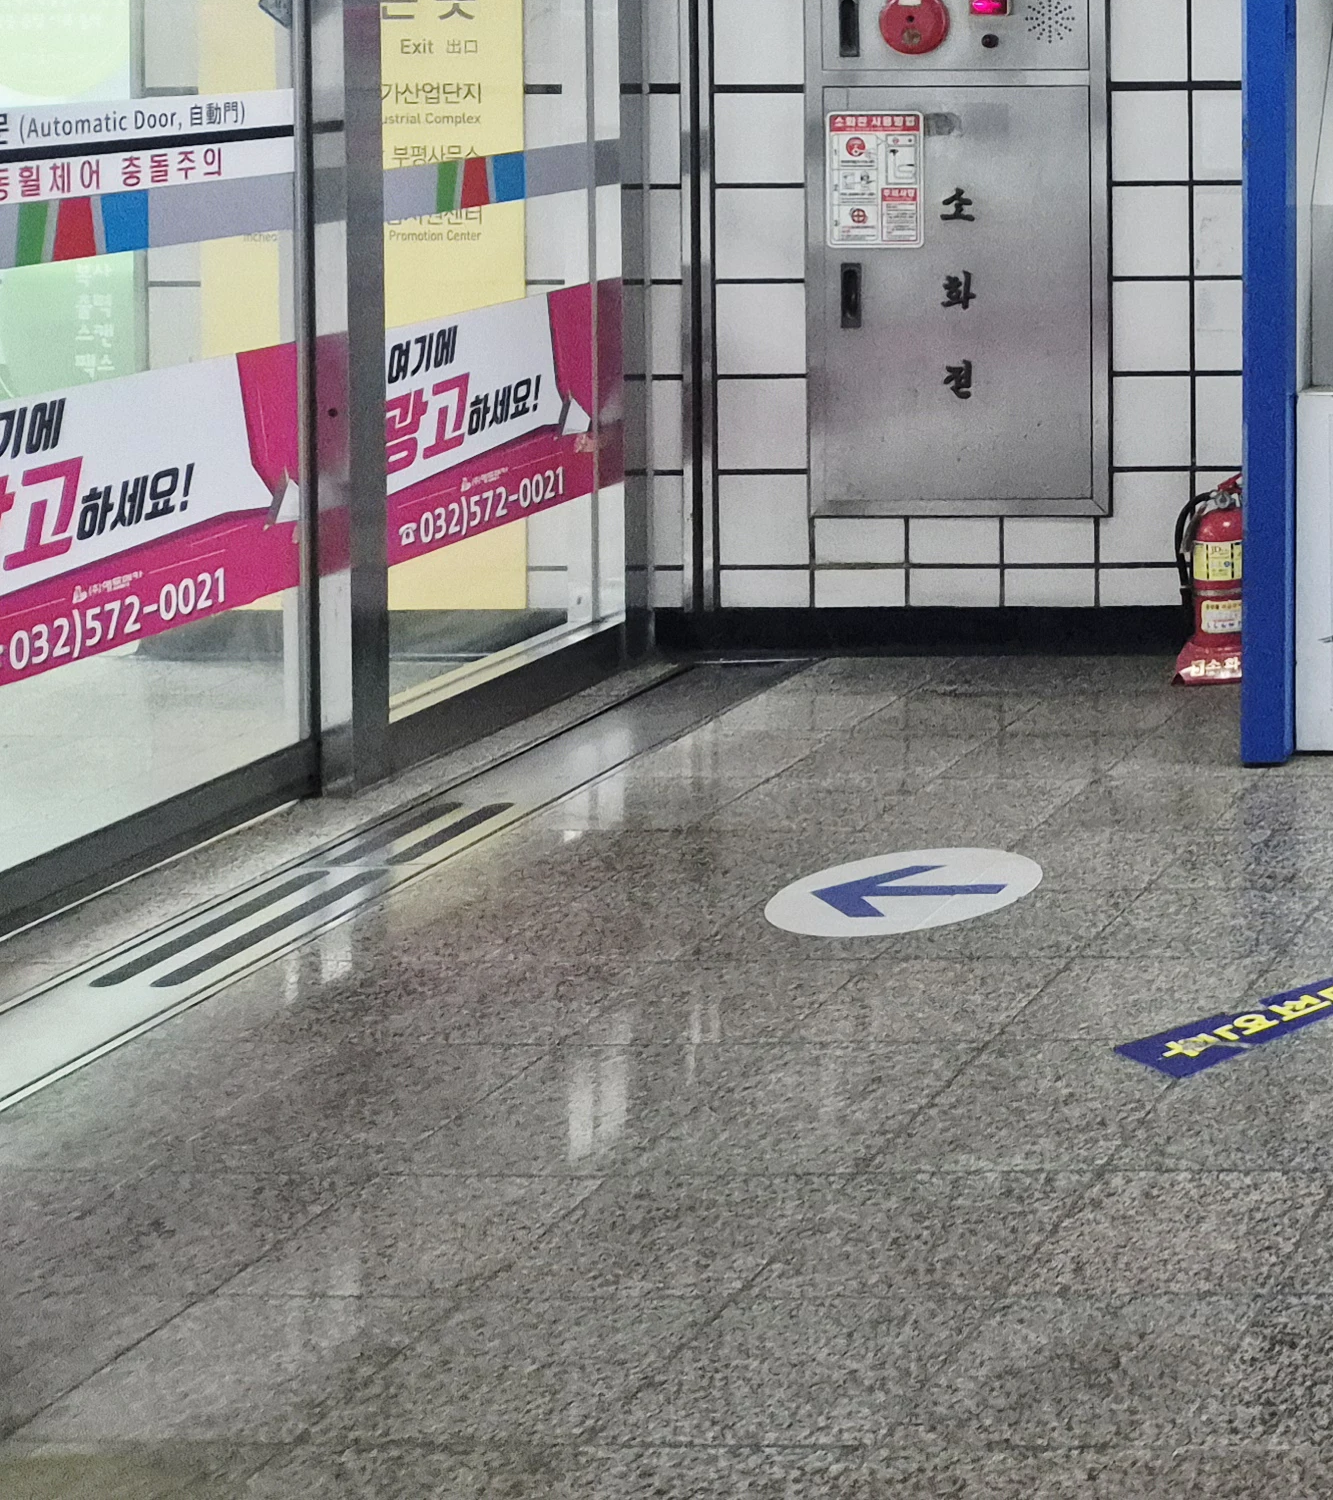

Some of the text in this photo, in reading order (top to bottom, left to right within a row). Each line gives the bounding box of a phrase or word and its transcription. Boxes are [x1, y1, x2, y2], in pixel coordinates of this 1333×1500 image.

[400, 38, 478, 55] Exit 出口
[19, 112, 128, 145] (Automatic
[133, 108, 183, 132] Door,
[189, 100, 246, 128] 自動門)
[424, 111, 481, 127] Complex
[121, 147, 223, 187] 충돌주의
[389, 230, 482, 241] Promotion Center
[940, 186, 977, 400] 소화전
[387, 325, 458, 385] 여기에
[420, 465, 564, 544] 032)572-0021
[9, 567, 227, 671] 032)572-0021
